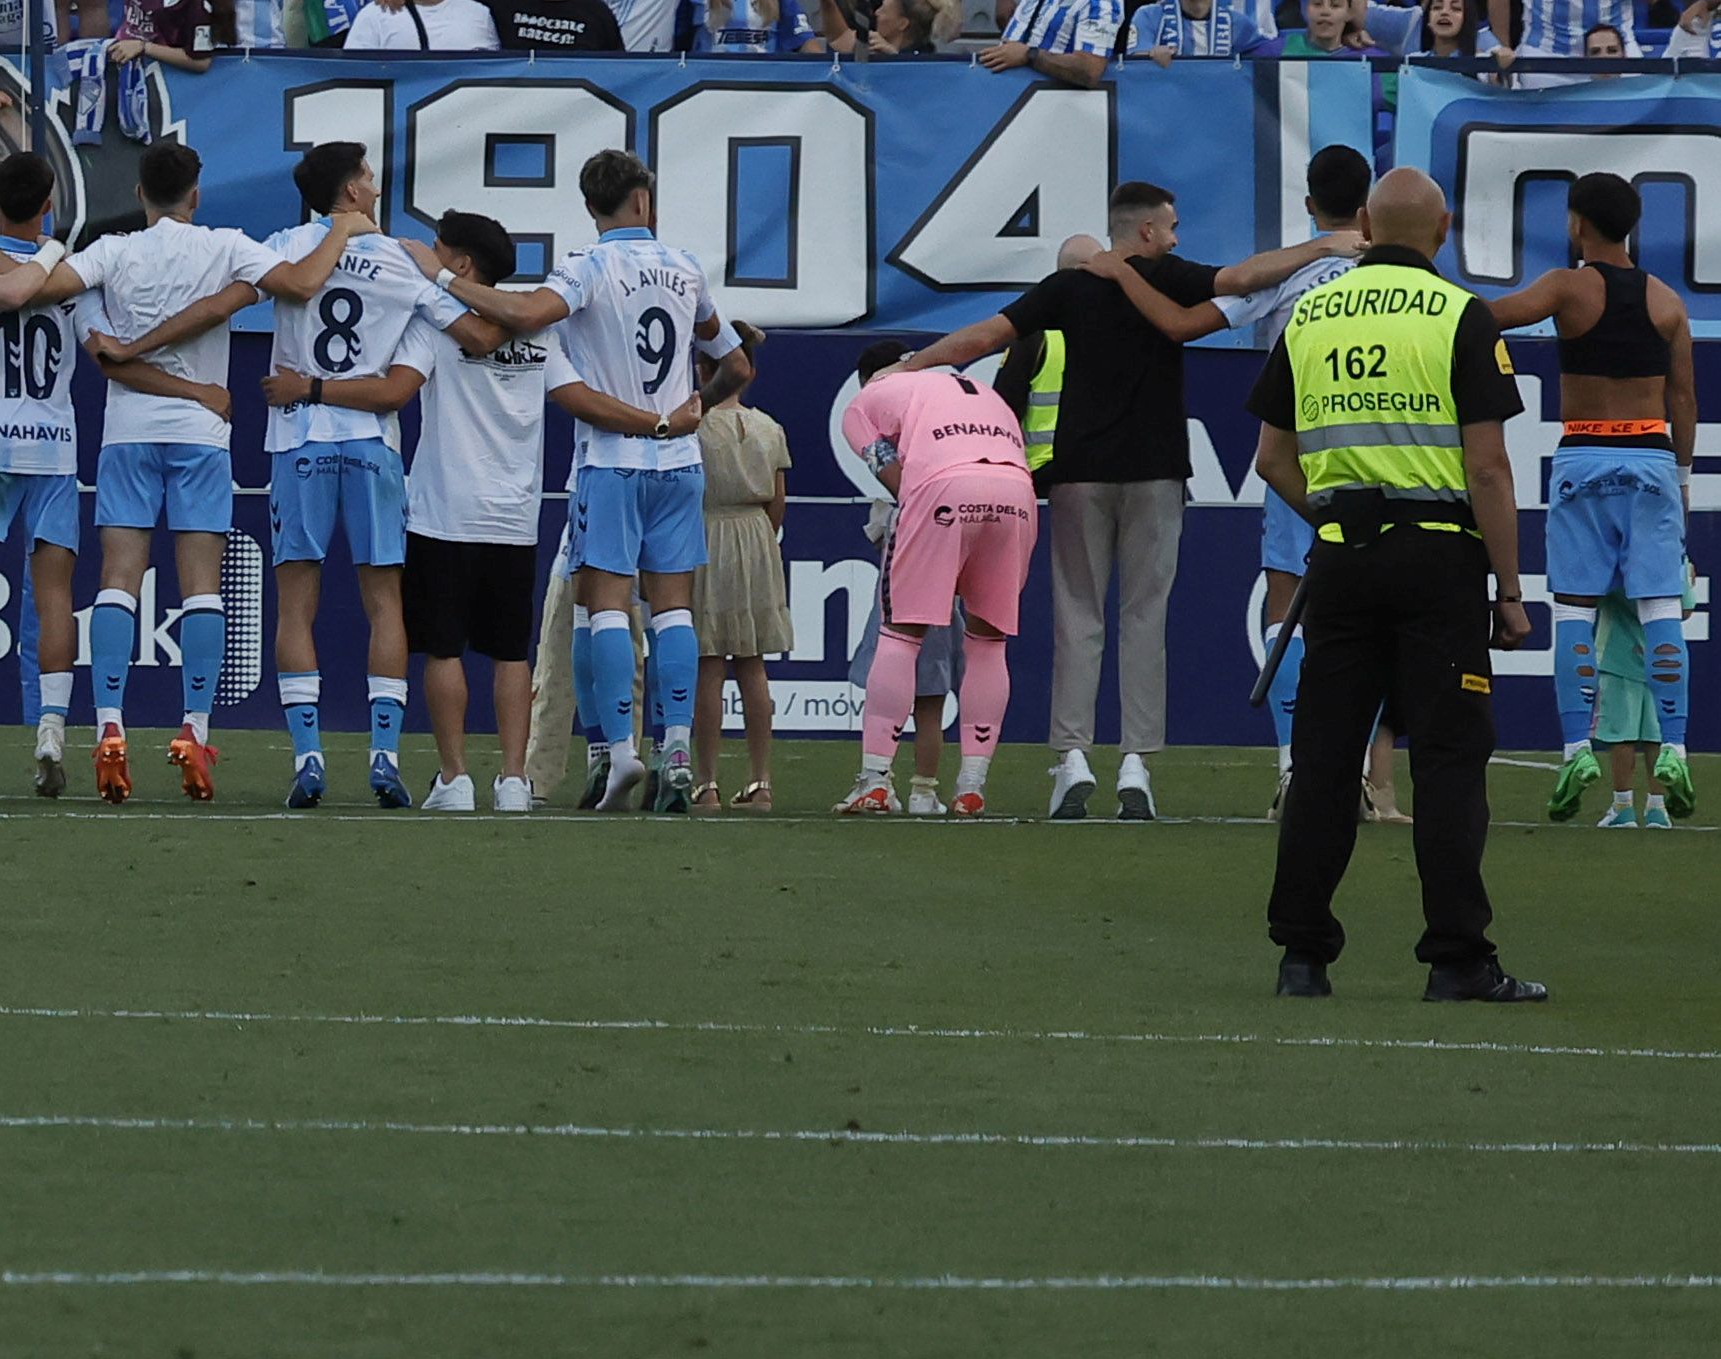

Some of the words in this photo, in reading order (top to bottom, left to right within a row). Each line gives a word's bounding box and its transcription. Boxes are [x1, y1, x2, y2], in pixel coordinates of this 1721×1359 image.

[290, 84, 1111, 323] 1904
[619, 279, 637, 297] J.
[1295, 288, 1448, 327] SEGURIDAD
[312, 287, 364, 374] 8
[635, 305, 677, 396] 9
[1324, 343, 1388, 384] 162
[1321, 393, 1442, 415] PROSEGUR
[1566, 423, 1604, 434] NIKE
[959, 503, 995, 514] COSTA
[995, 505, 1017, 515] DEL
